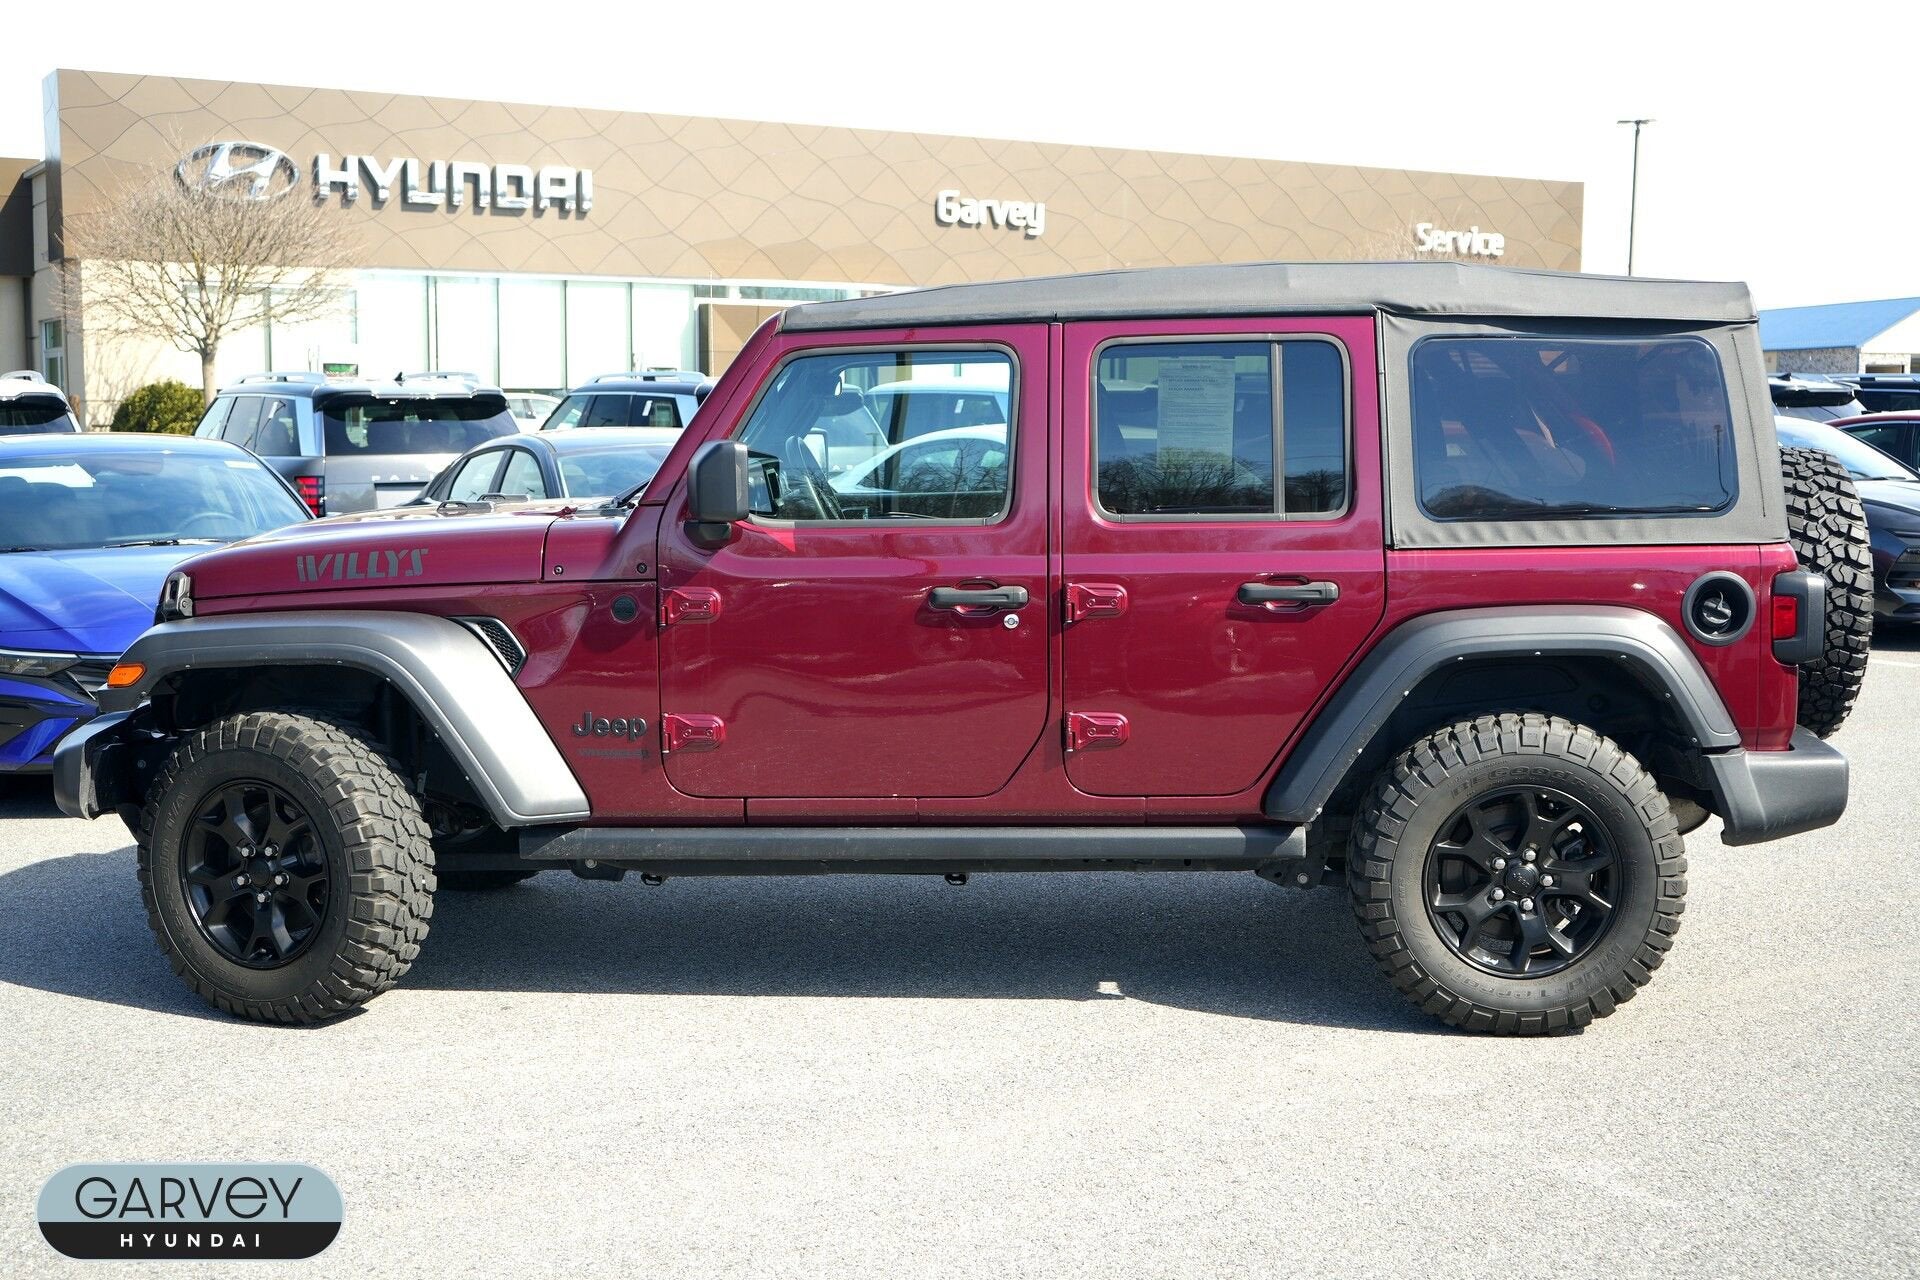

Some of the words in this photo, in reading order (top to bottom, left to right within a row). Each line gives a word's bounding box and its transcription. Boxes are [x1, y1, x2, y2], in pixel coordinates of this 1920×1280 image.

[314, 153, 593, 218] HYUNDAI
[936, 189, 1046, 238] Garvey
[1415, 222, 1505, 256] Service
[296, 548, 429, 582] WILLYS
[573, 711, 647, 742] Jeep
